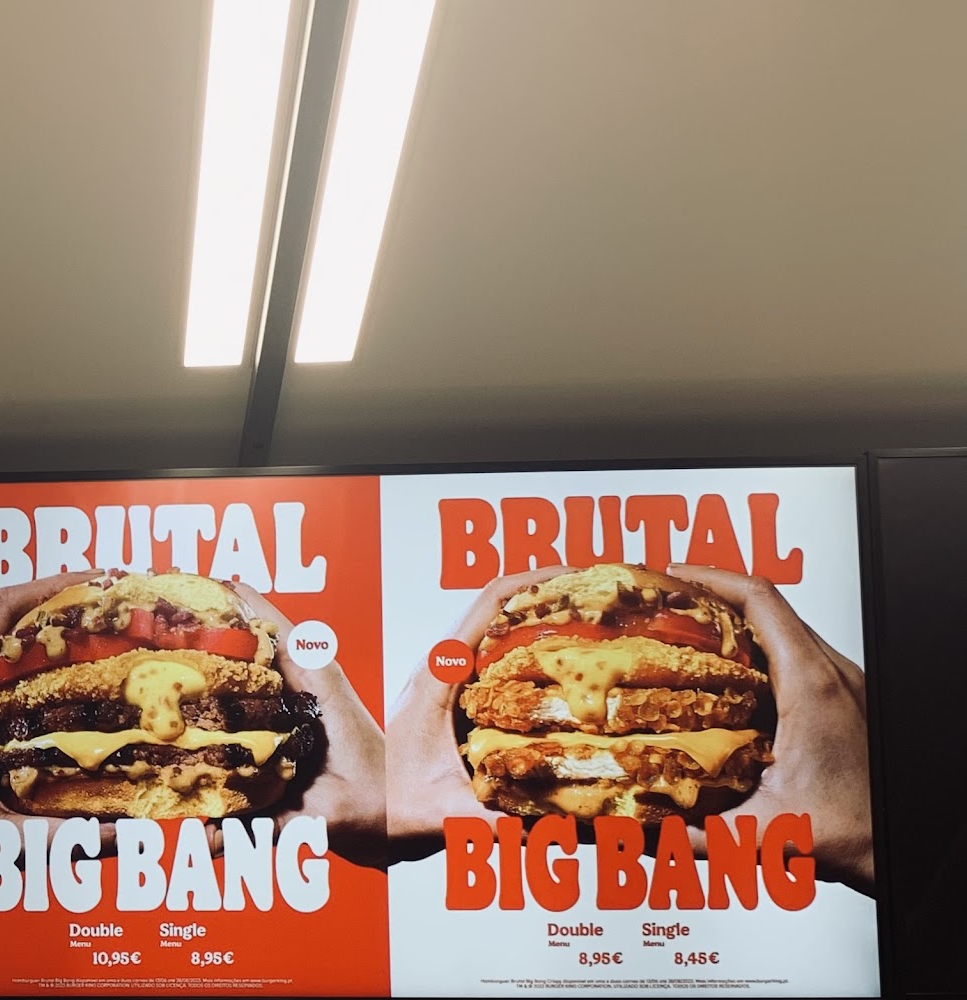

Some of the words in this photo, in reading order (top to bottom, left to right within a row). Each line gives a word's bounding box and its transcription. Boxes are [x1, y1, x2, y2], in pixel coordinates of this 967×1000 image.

[438, 493, 803, 591] BRUTAL
[296, 639, 328, 650] Novo
[436, 656, 466, 666] Novo
[115, 815, 331, 912] BANG
[442, 813, 581, 912] BIG
[595, 812, 817, 911] BANG
[70, 923, 123, 936] Double
[160, 923, 206, 940] Single
[548, 923, 603, 936] Double
[642, 923, 689, 939] Single
[93, 952, 141, 967] 10,95€
[191, 952, 234, 967] 8,95€
[579, 952, 623, 967] 8,95€
[675, 952, 719, 967] 8,45€
